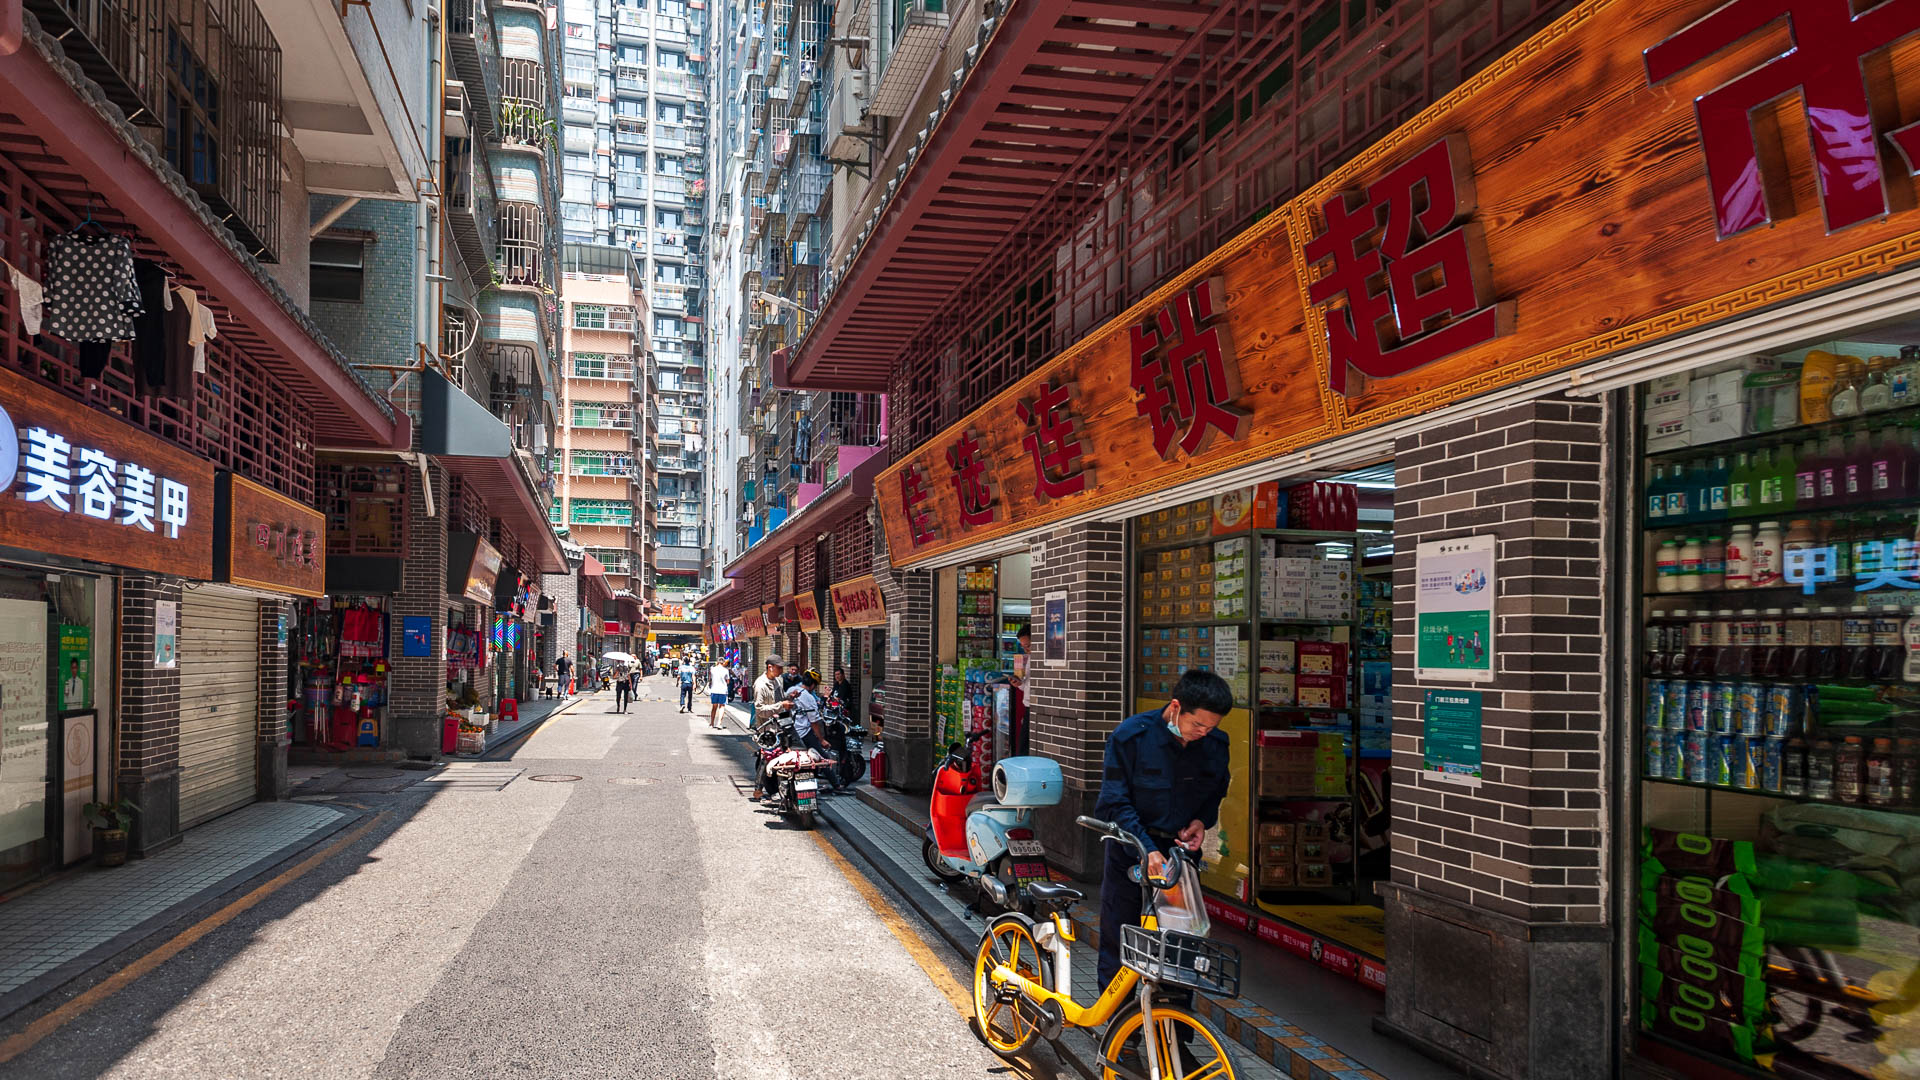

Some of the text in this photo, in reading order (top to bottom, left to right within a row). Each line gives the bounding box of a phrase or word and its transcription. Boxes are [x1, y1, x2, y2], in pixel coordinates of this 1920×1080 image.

[25, 426, 189, 539] 美容美甲
[1107, 966, 1130, 998] 美团单车
